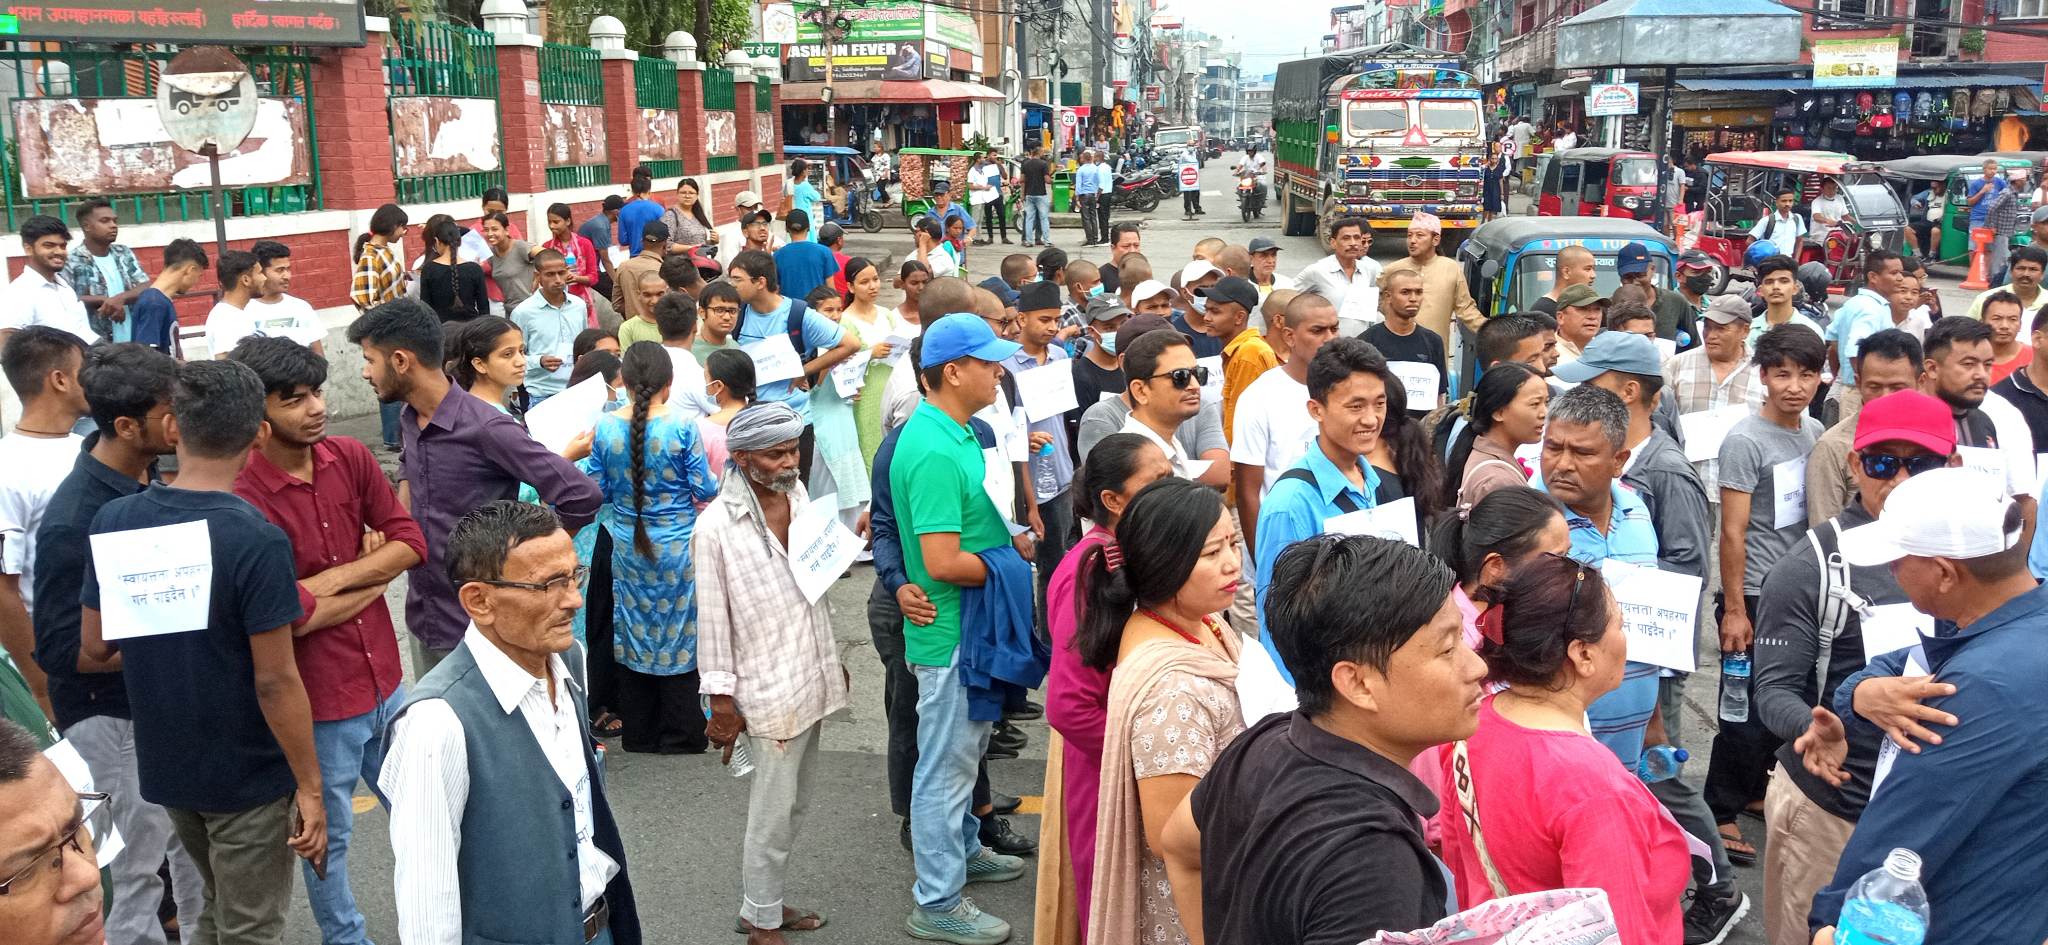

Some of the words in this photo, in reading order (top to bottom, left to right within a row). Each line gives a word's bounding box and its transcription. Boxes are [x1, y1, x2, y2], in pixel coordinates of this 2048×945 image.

[851, 42, 897, 57] FEVER
[1064, 115, 1075, 123] 20
[1657, 607, 1688, 624] अपहरण
